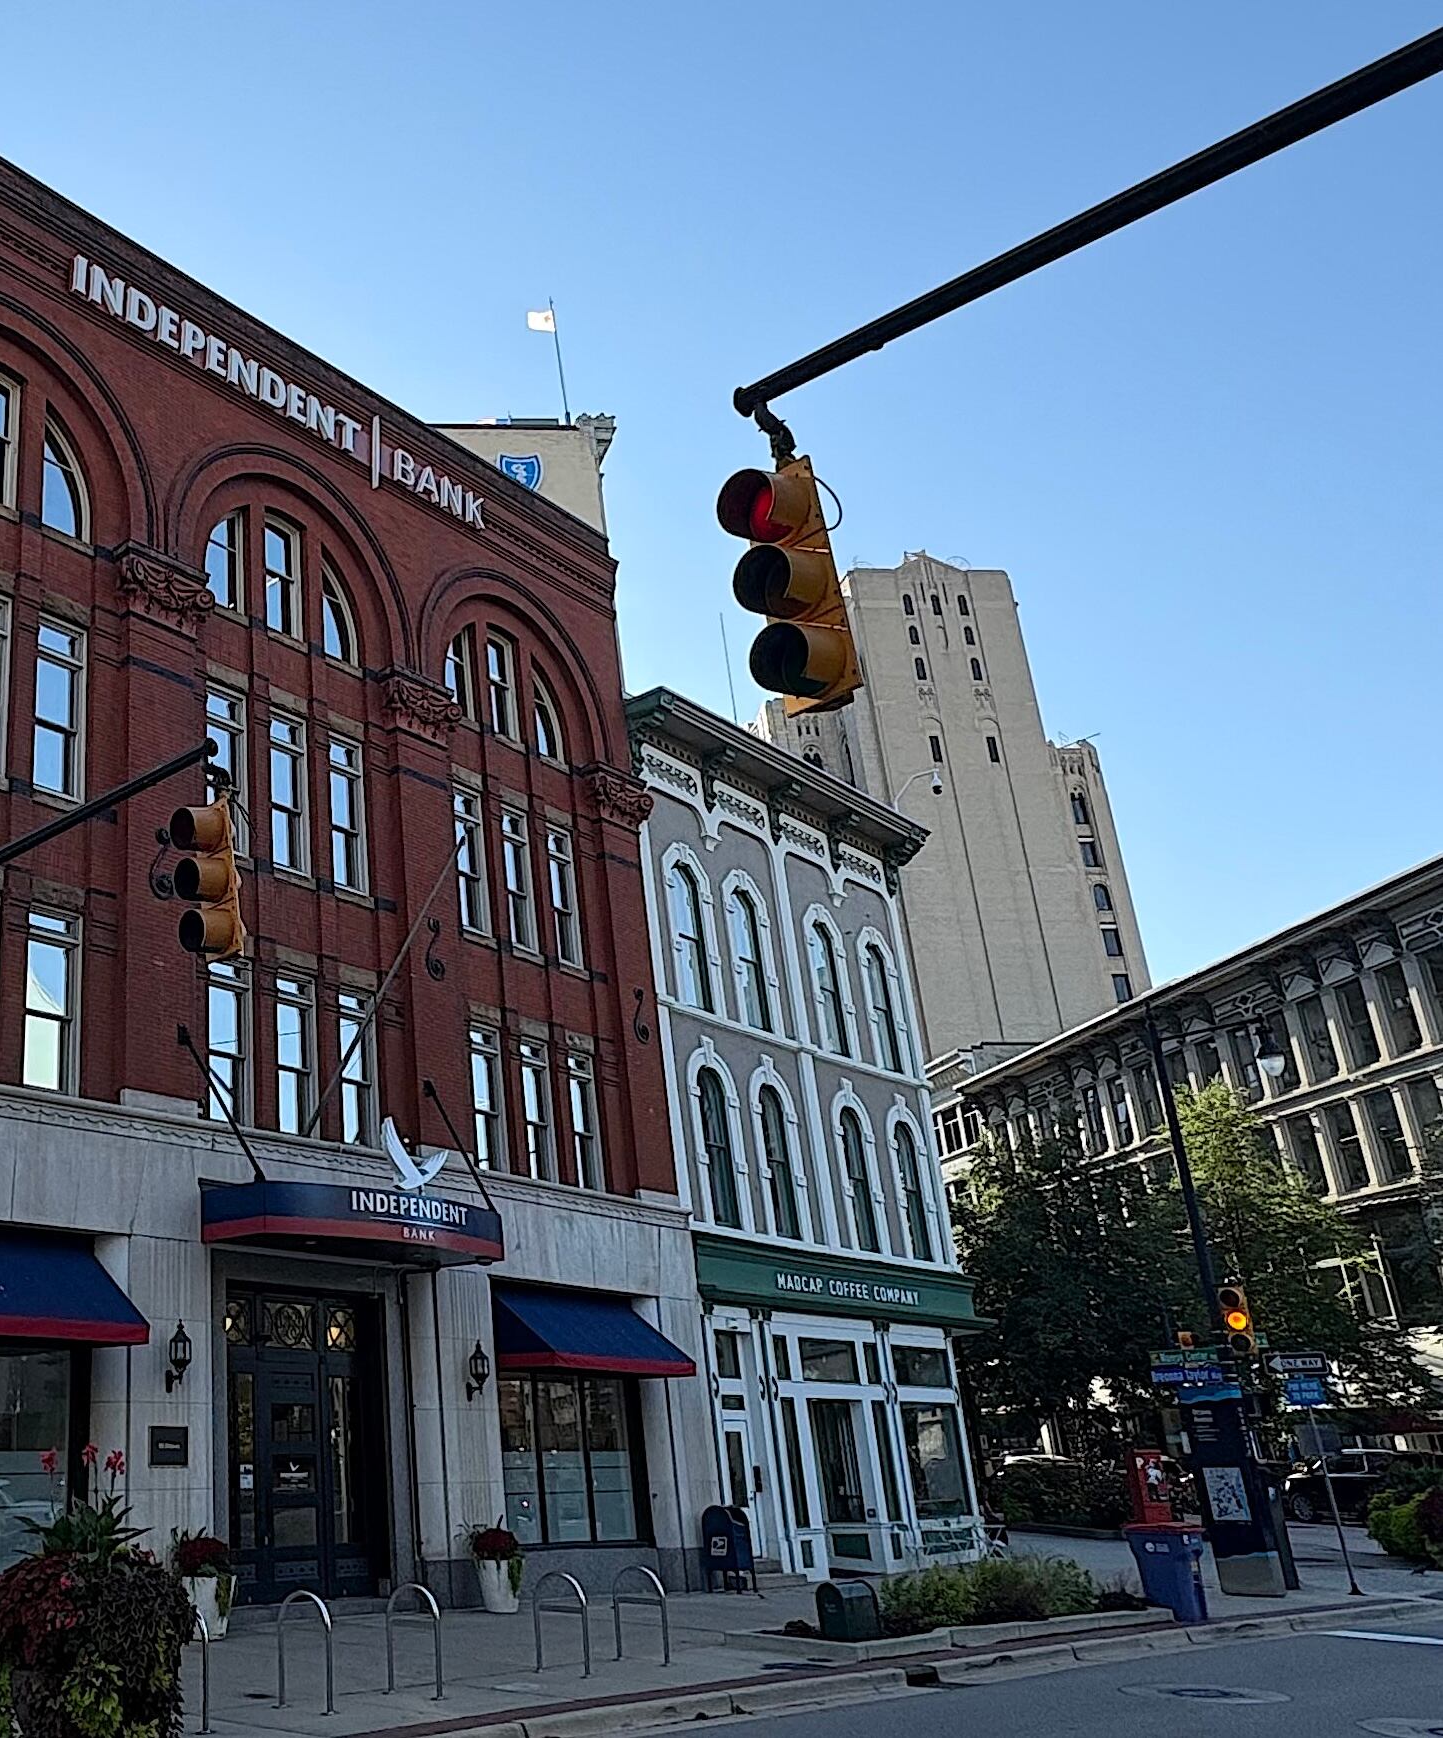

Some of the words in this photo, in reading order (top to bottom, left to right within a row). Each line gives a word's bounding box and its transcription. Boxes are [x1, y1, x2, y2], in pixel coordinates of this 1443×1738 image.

[70, 254, 362, 456] INDEPENDENT
[392, 447, 487, 531] BANK
[351, 1190, 468, 1226] INDEPENDENT
[403, 1227, 436, 1241] BANK
[776, 1273, 824, 1294] MADCAP
[828, 1280, 870, 1300] COFFEE
[873, 1285, 920, 1306] COMPANY
[1281, 1359, 1300, 1367] ONE
[1302, 1359, 1320, 1367] WAY
